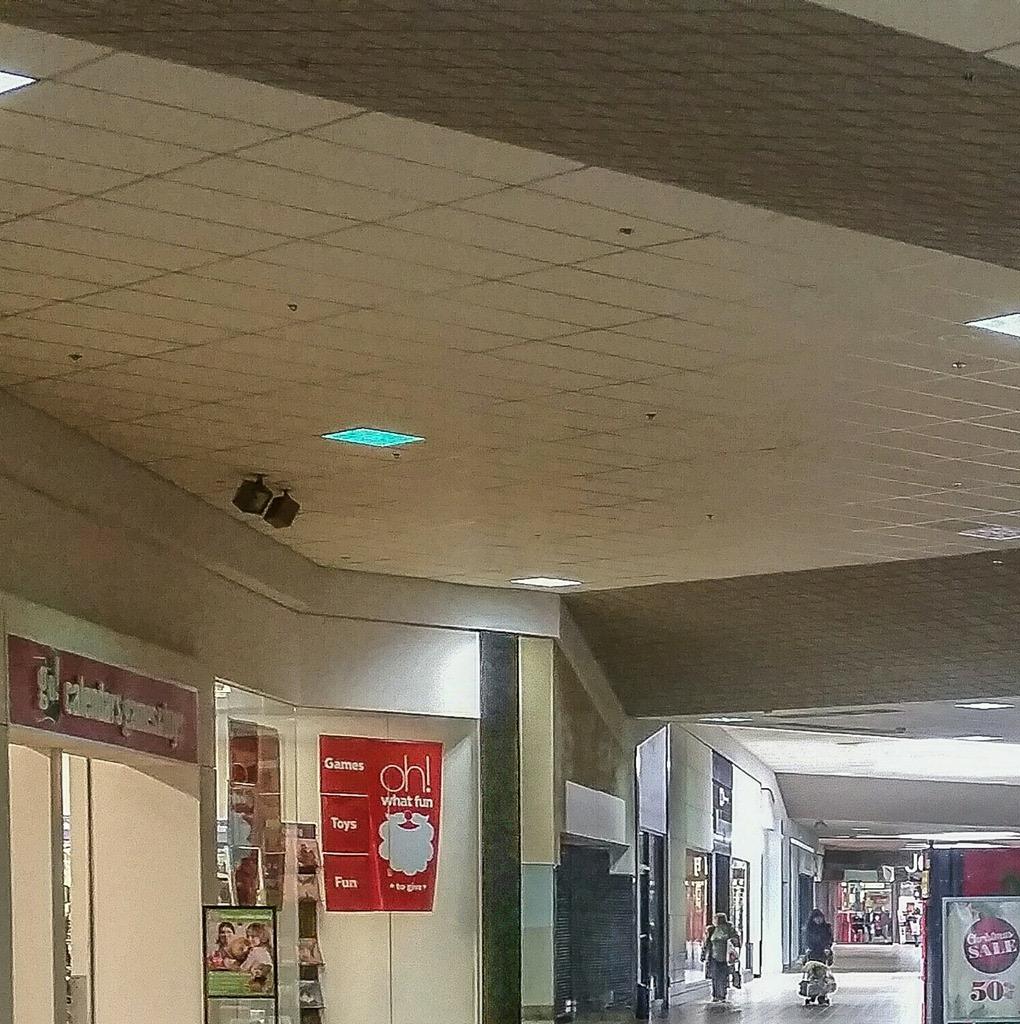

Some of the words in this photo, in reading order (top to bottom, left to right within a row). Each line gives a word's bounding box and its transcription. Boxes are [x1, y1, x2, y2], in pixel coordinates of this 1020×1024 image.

[324, 757, 365, 771] Games
[380, 754, 432, 793] oh!
[381, 795, 412, 808] what
[414, 795, 433, 808] fun
[331, 817, 357, 832] Toys
[334, 876, 358, 888] Fun
[395, 883, 406, 891] to
[967, 939, 1017, 959] SALE
